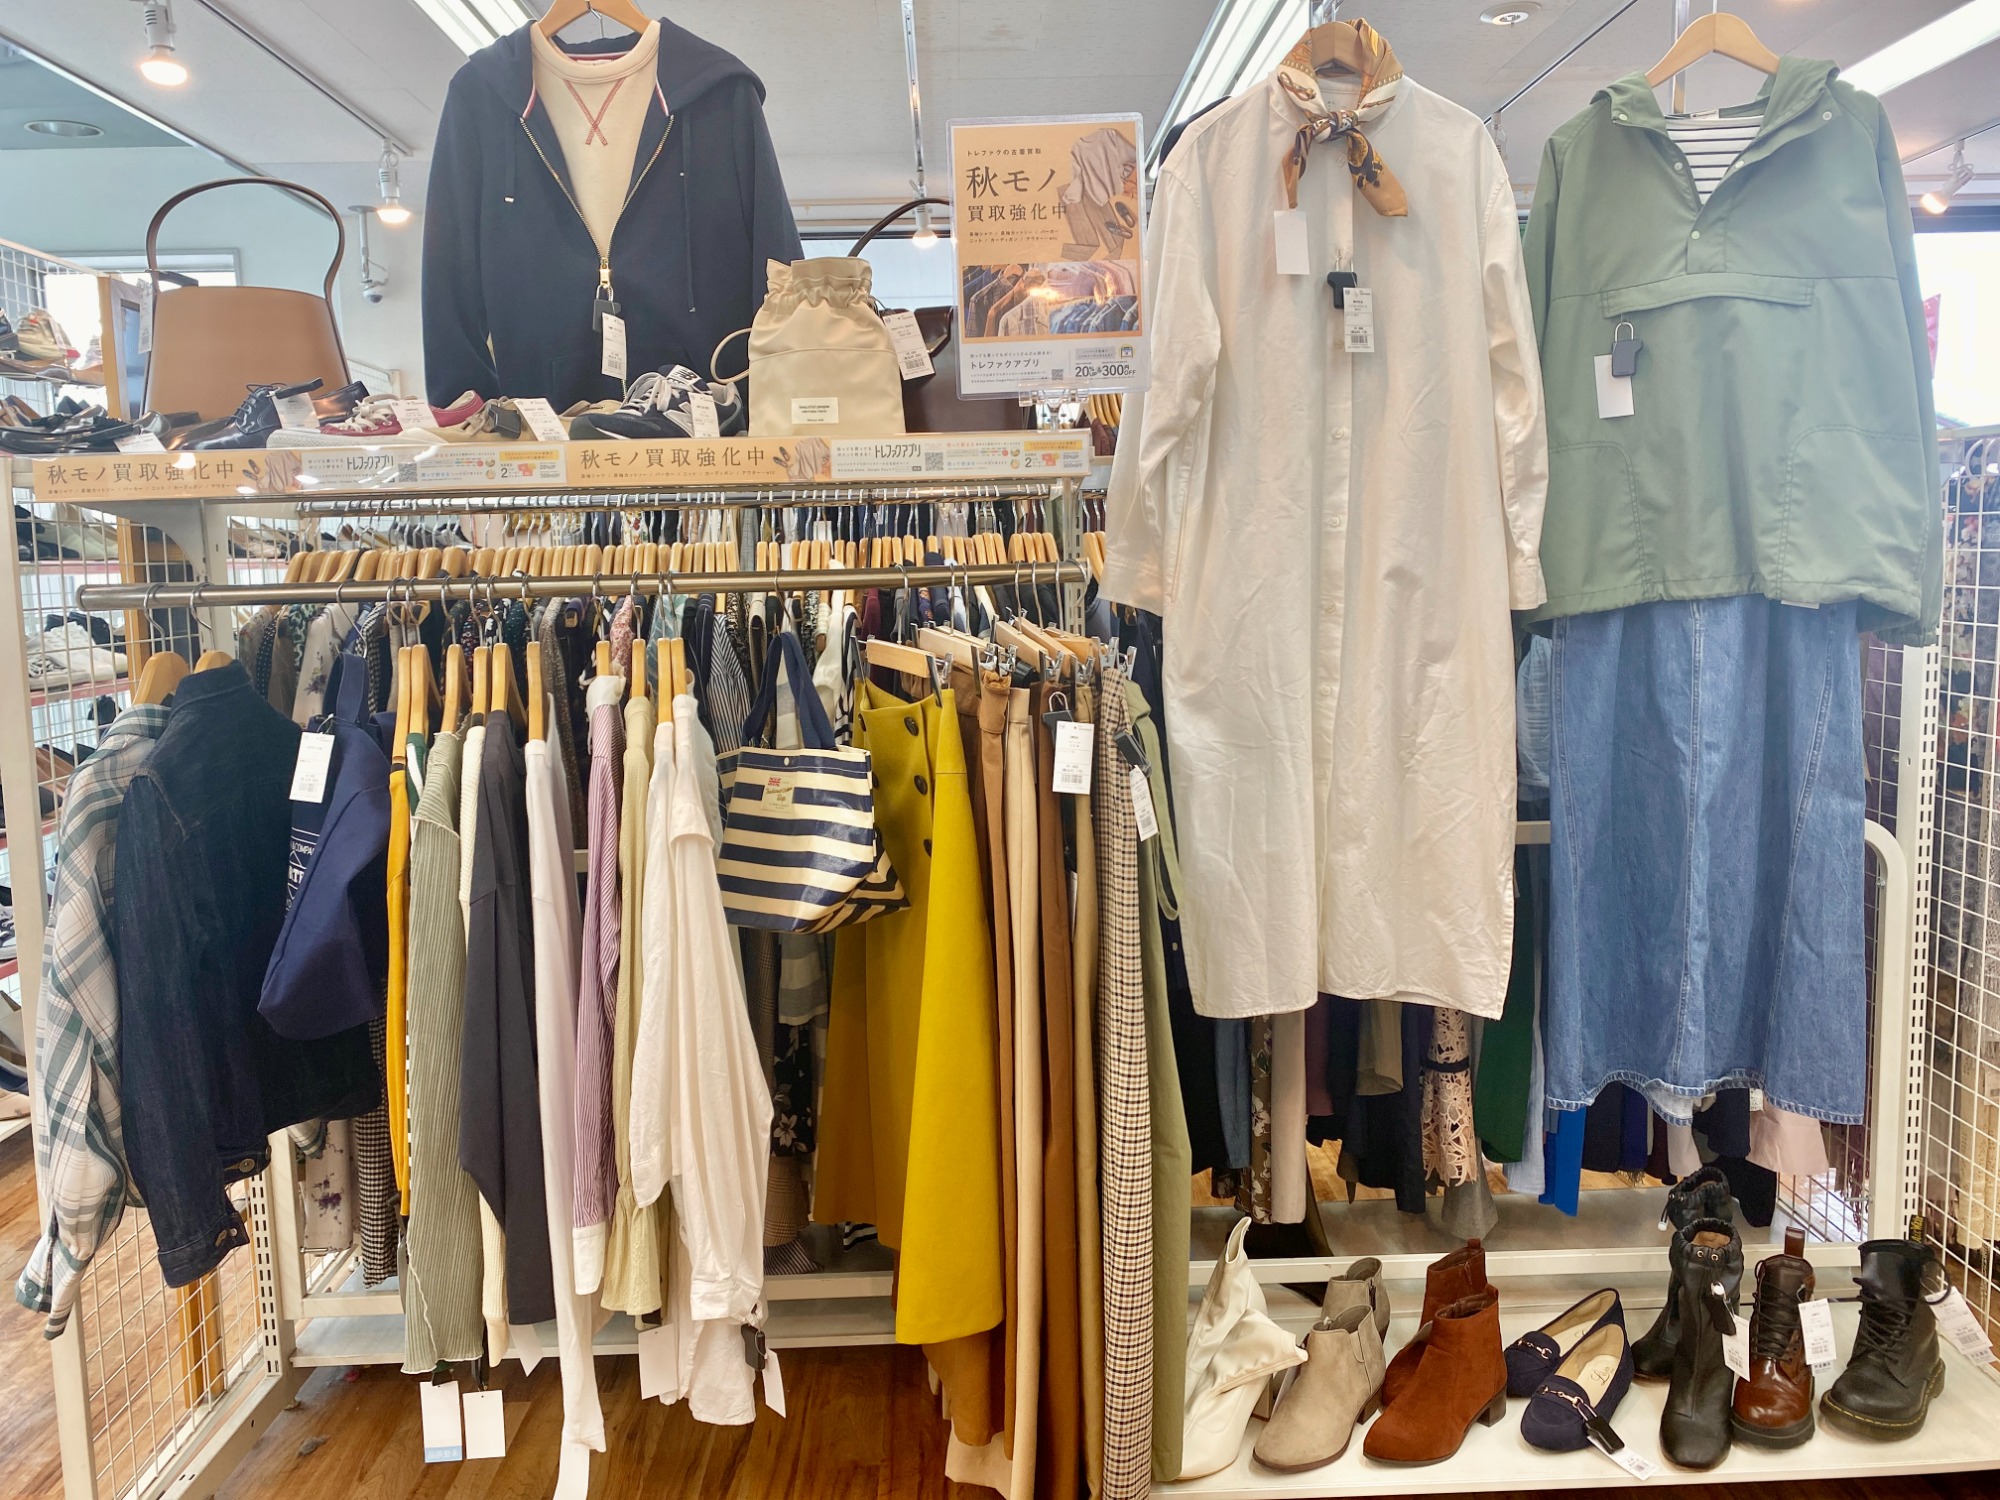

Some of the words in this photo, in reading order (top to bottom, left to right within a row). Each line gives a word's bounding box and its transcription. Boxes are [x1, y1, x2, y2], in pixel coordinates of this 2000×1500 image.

[966, 148, 1042, 157] トレファクの古着買取
[966, 166, 1056, 199] 秋モノ
[967, 202, 1067, 223] 買取強化中
[971, 359, 1040, 370] トレファクアプリ
[580, 446, 765, 470] 秋モノ買取強化中
[875, 443, 921, 458] トレファクアプリ
[346, 455, 394, 471] トレファクアプリ
[1025, 457, 1032, 468] 2
[47, 459, 234, 485] 秋モノ買取強化中
[500, 467, 508, 478] 2
